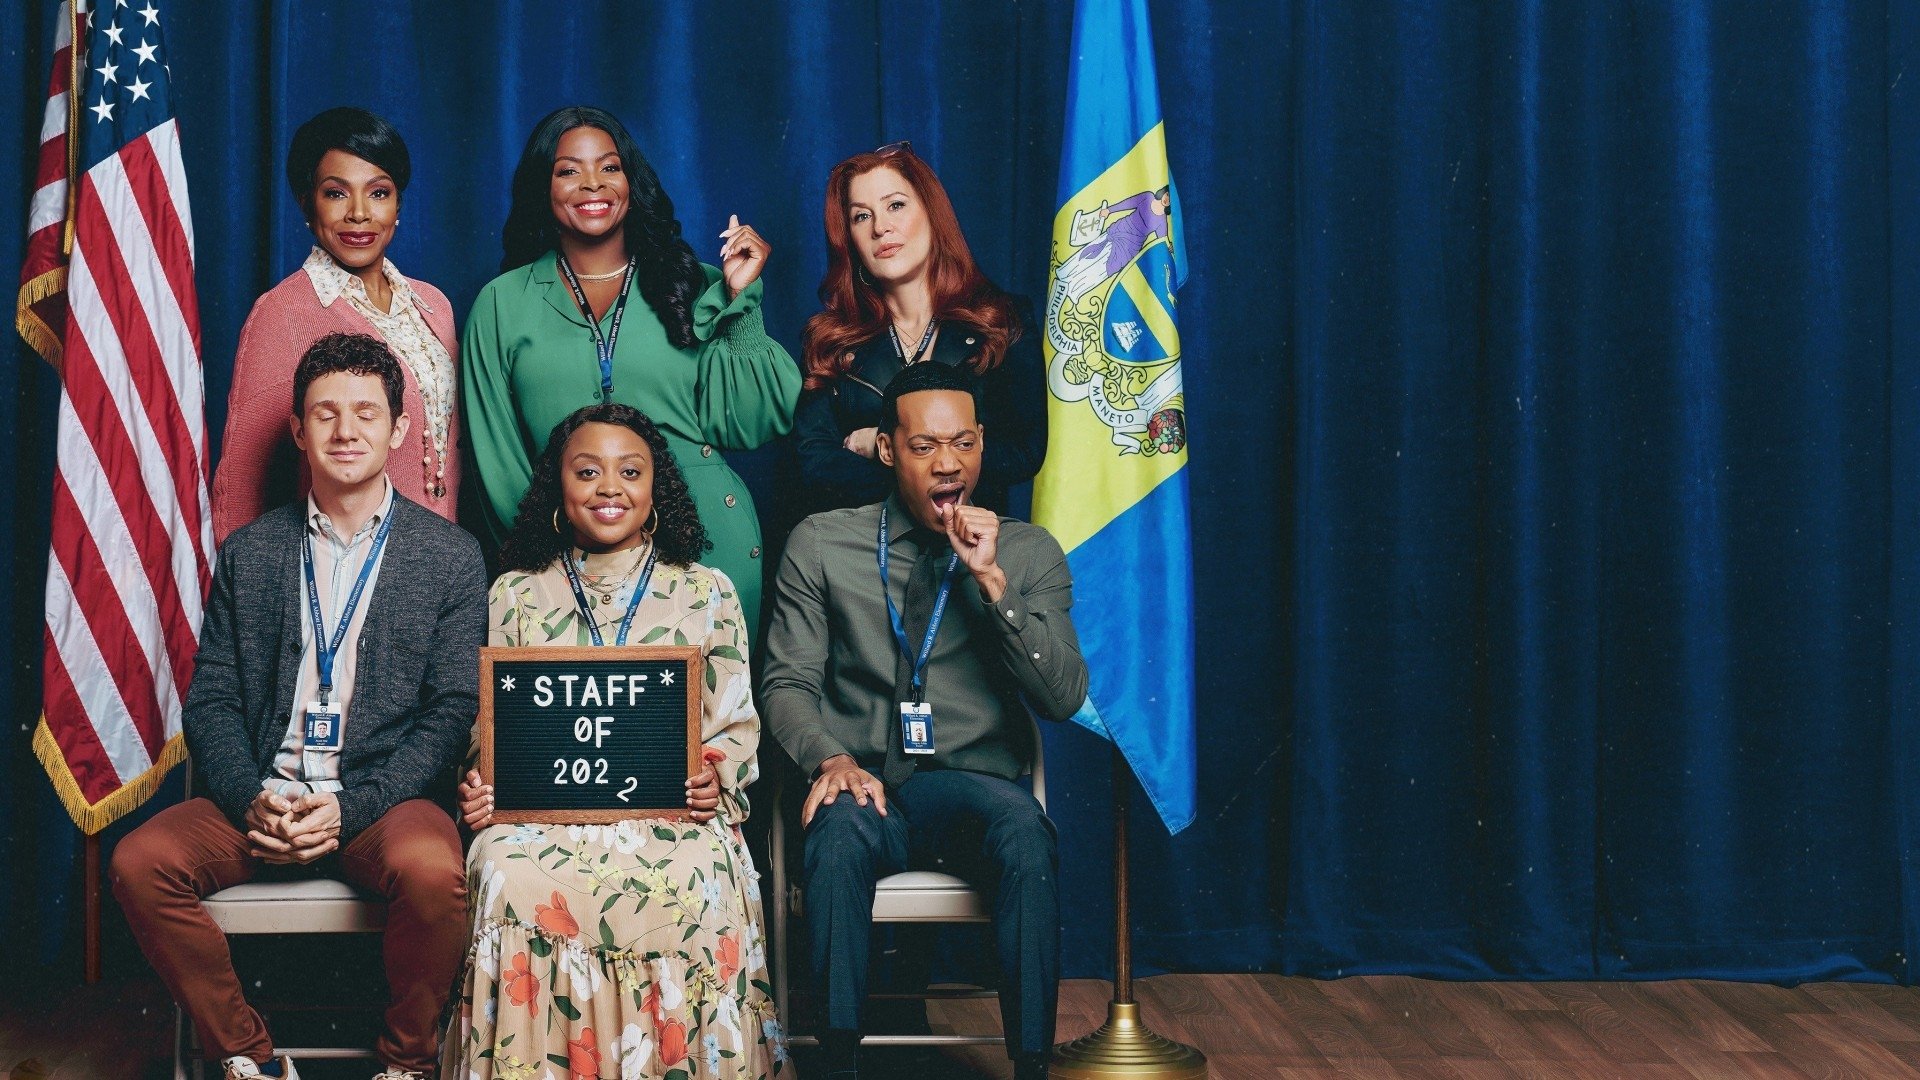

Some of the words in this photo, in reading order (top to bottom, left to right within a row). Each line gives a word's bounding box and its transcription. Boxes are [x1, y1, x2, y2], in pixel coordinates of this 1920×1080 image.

[1049, 284, 1078, 352] PHILADELPHIA
[1092, 385, 1134, 424] MANETO
[533, 674, 648, 707] STAFF
